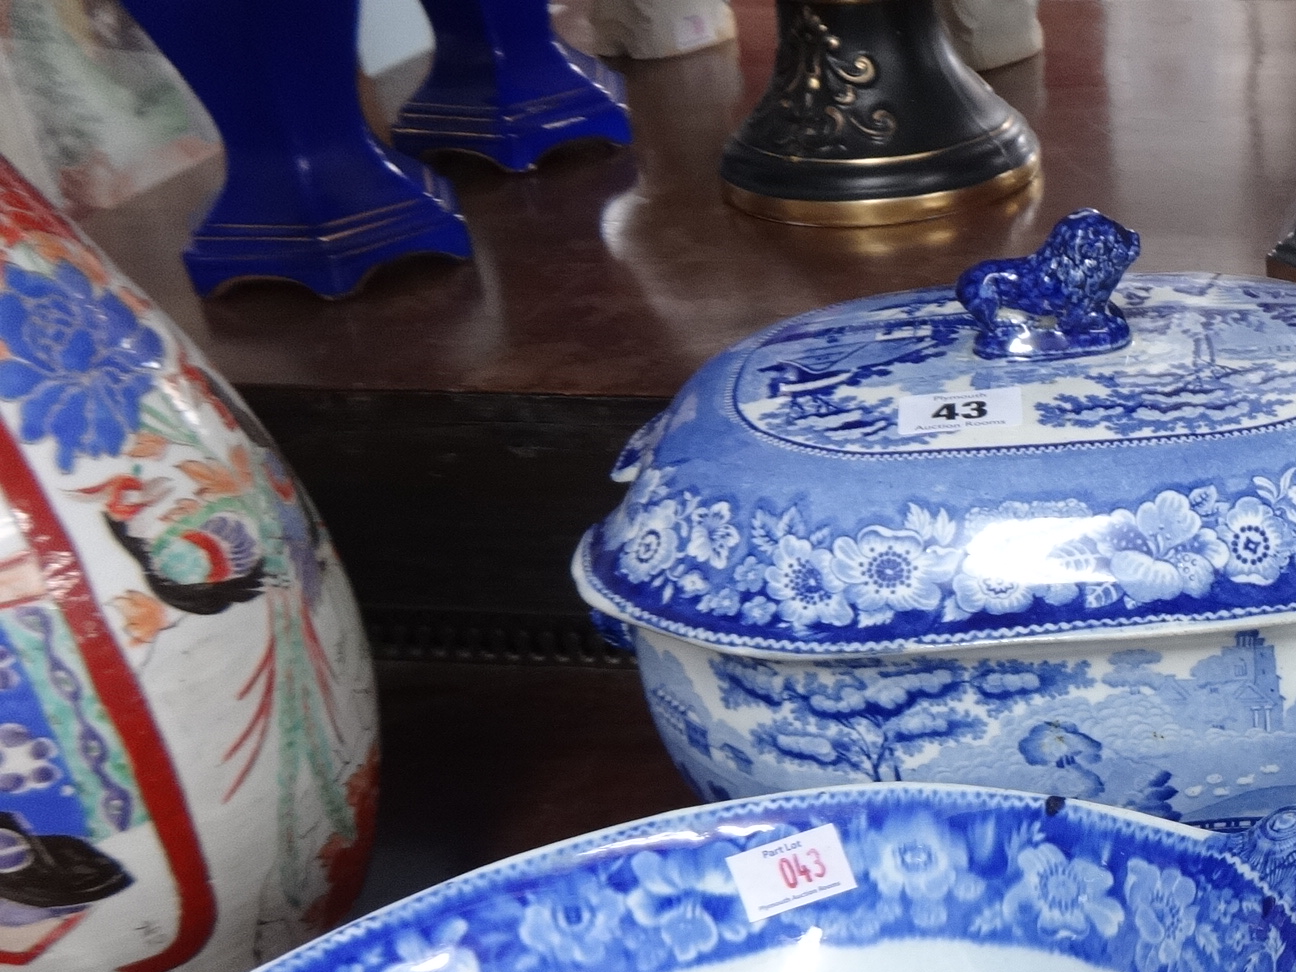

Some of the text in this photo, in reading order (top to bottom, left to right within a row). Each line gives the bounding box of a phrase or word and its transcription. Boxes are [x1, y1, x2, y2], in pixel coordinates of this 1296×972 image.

[931, 400, 988, 420] 43
[762, 840, 802, 858] Part Lot
[779, 848, 827, 889] 043
